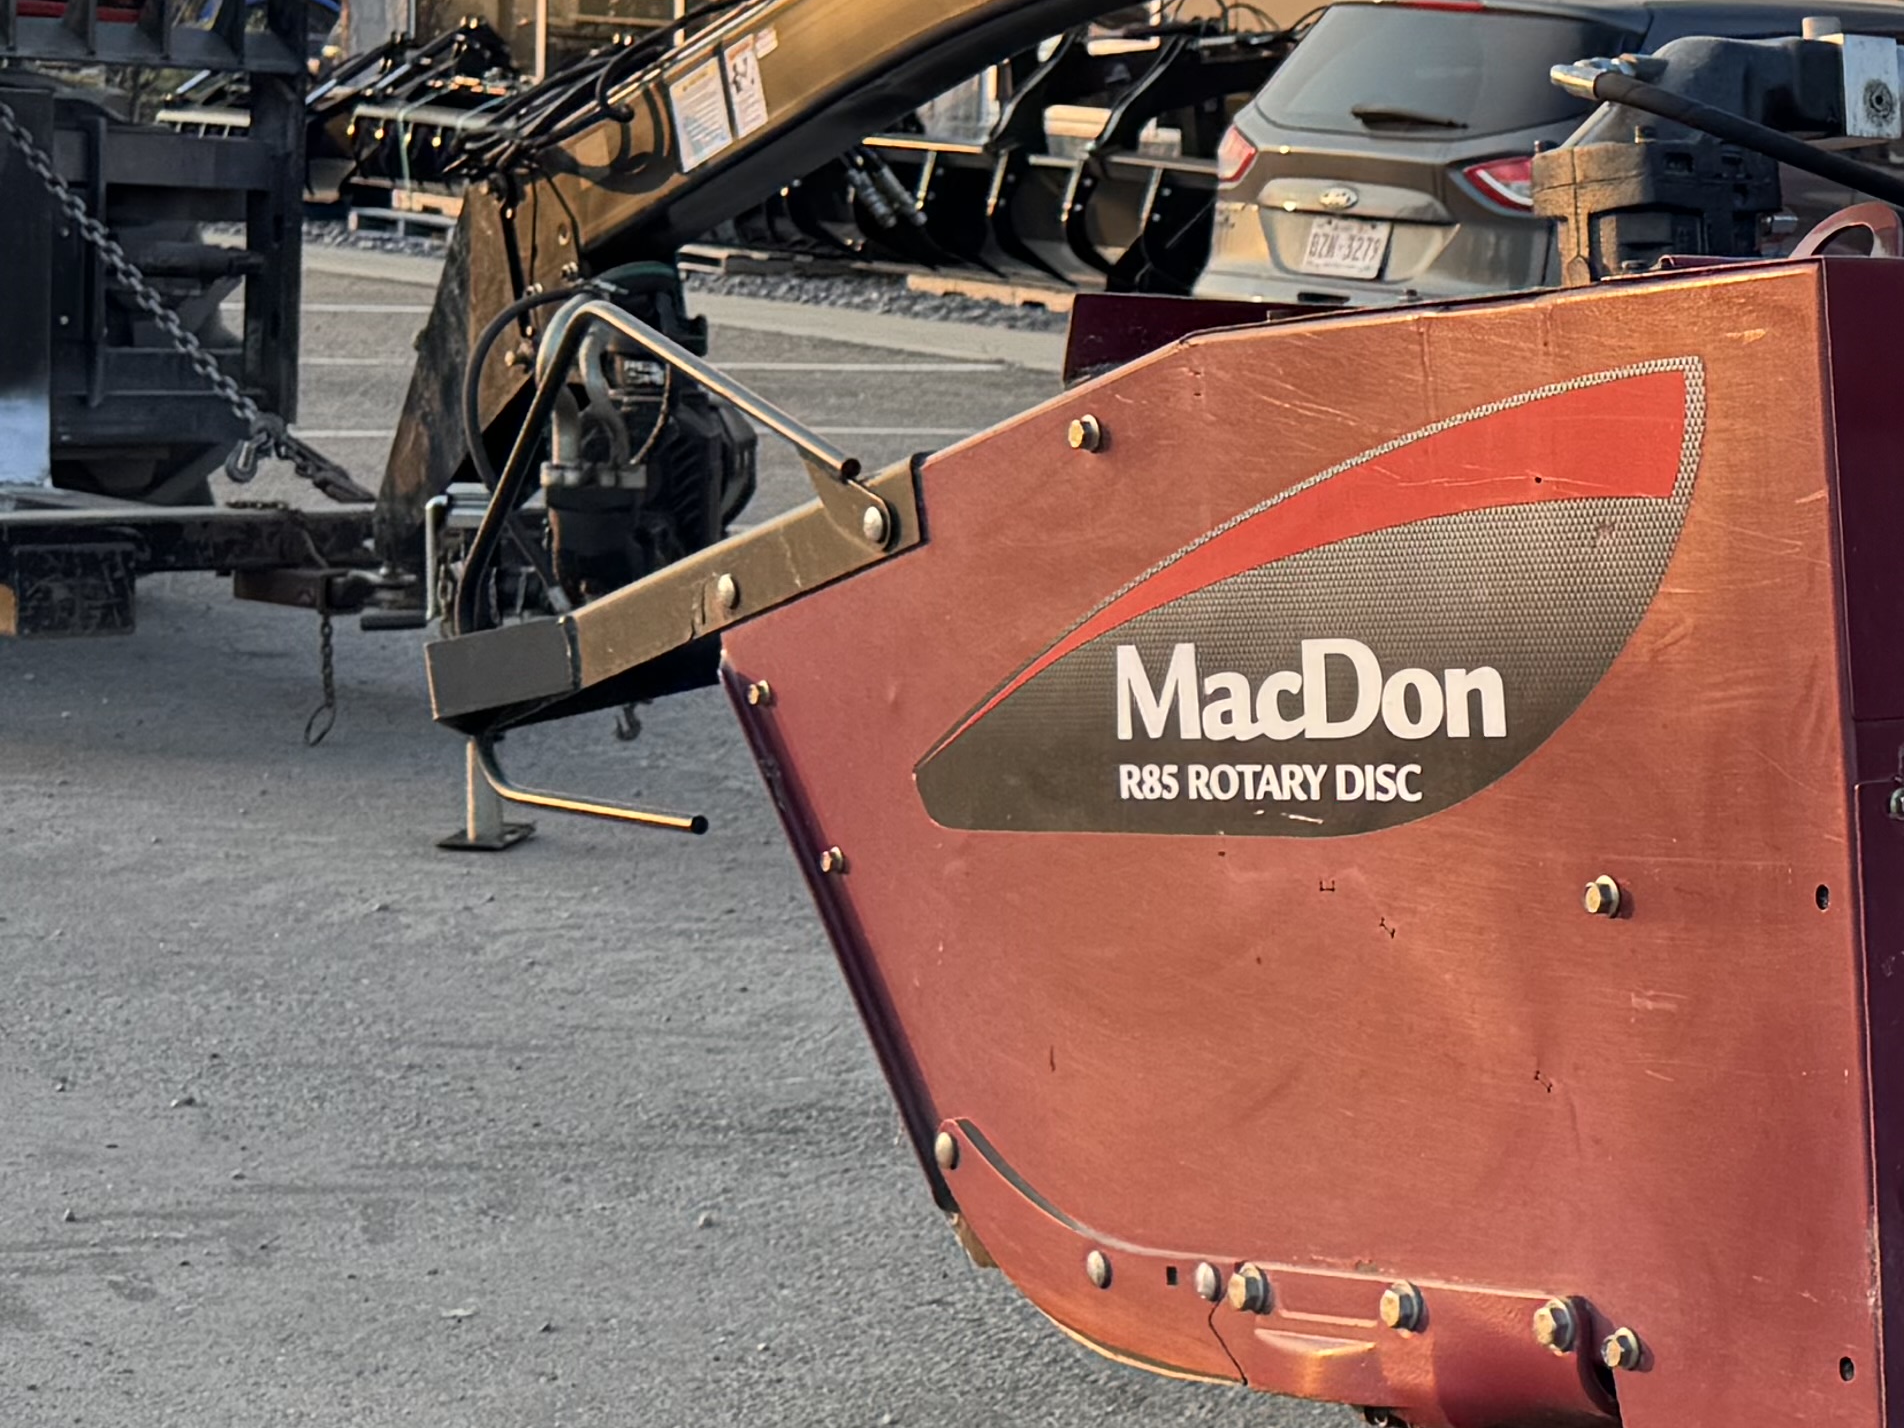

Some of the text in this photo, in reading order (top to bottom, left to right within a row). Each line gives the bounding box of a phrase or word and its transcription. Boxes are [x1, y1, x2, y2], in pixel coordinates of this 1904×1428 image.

[1116, 638, 1507, 740] MacDon
[1120, 764, 1422, 802] R85 ROTARY DISC
